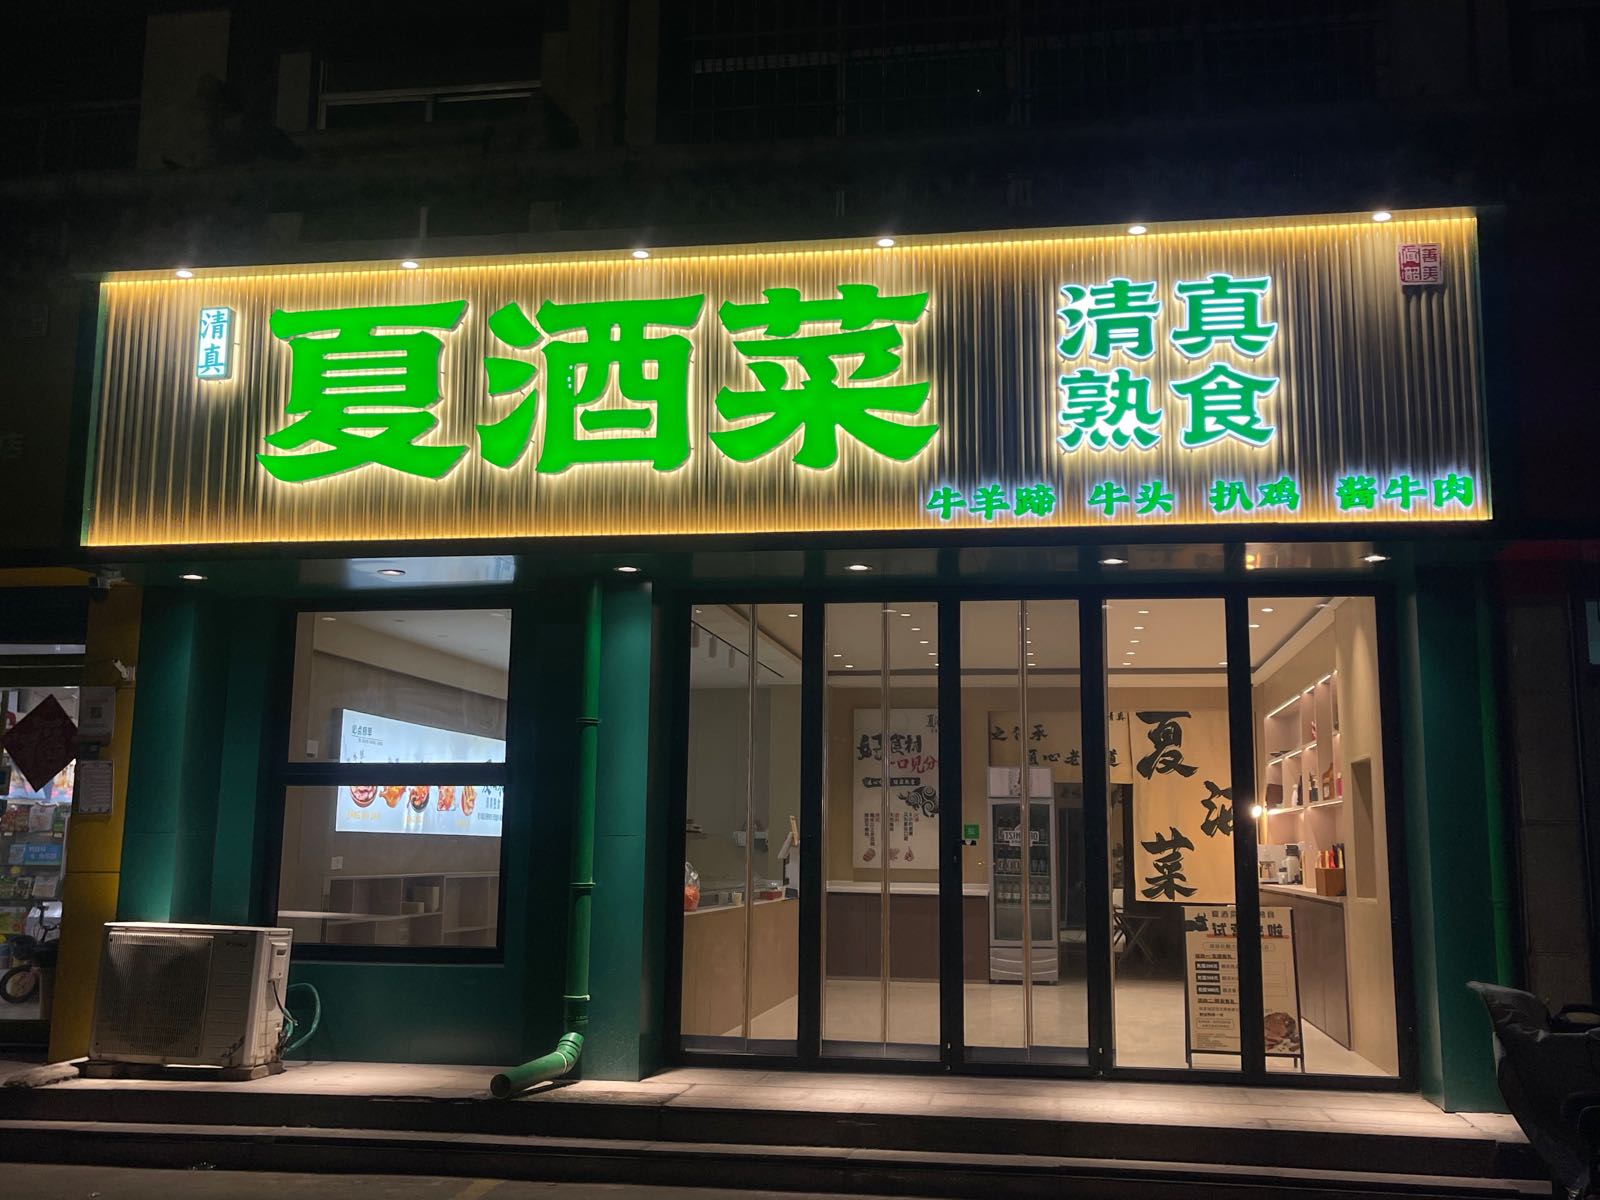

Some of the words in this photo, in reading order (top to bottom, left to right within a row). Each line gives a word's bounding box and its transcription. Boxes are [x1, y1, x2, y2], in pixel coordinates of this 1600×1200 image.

[199, 310, 228, 374] 清真
[1058, 274, 1278, 360] 清真
[257, 284, 940, 482] 夏酒菜
[1058, 363, 1280, 450] 熟食
[926, 484, 1056, 520] 牛羊蹄
[1087, 481, 1174, 516] 牛头
[1209, 476, 1300, 512] 扒鸡
[1336, 473, 1475, 511] 酱牛肉
[1004, 831, 1038, 841] TSINO
